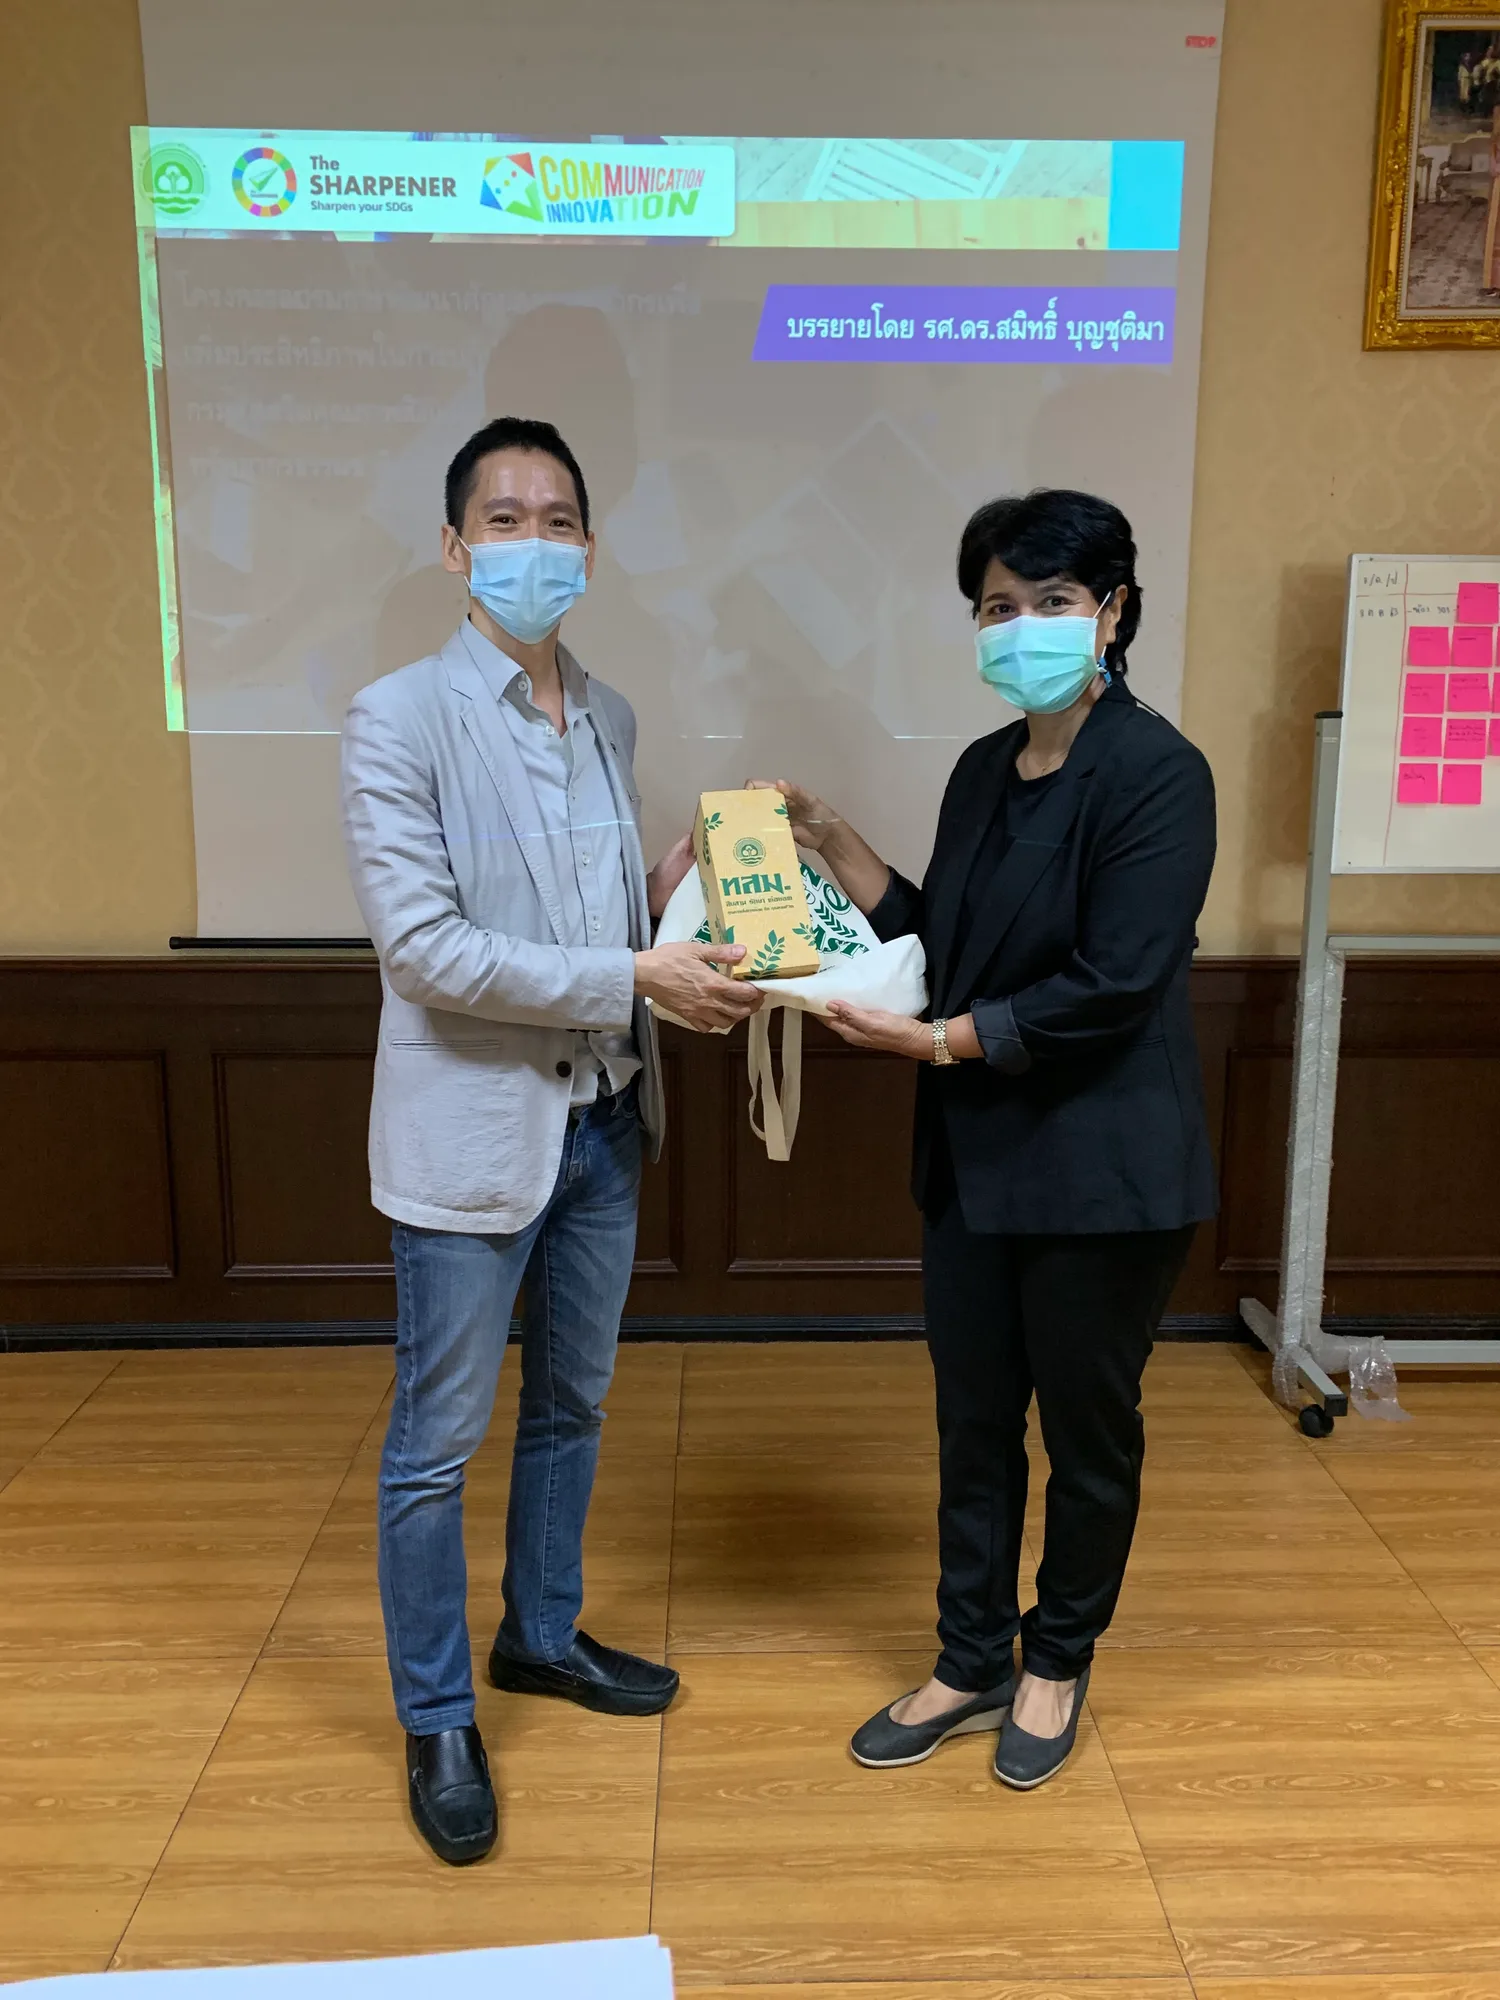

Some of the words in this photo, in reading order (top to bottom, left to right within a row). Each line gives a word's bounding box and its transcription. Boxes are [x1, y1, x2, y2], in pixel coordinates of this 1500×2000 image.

[309, 154, 340, 171] The
[309, 174, 457, 198] SHARPENER
[538, 155, 706, 203] COMMUNICATION
[310, 200, 356, 214] Sharpen
[359, 202, 383, 213] your
[385, 202, 414, 212] SDGs
[546, 189, 700, 224] INNOVATION
[786, 303, 915, 340] บรรยายโดย
[923, 297, 1059, 341] รศ.ดร.สมิทธิ์
[1066, 310, 1165, 352] บุญชุติมา
